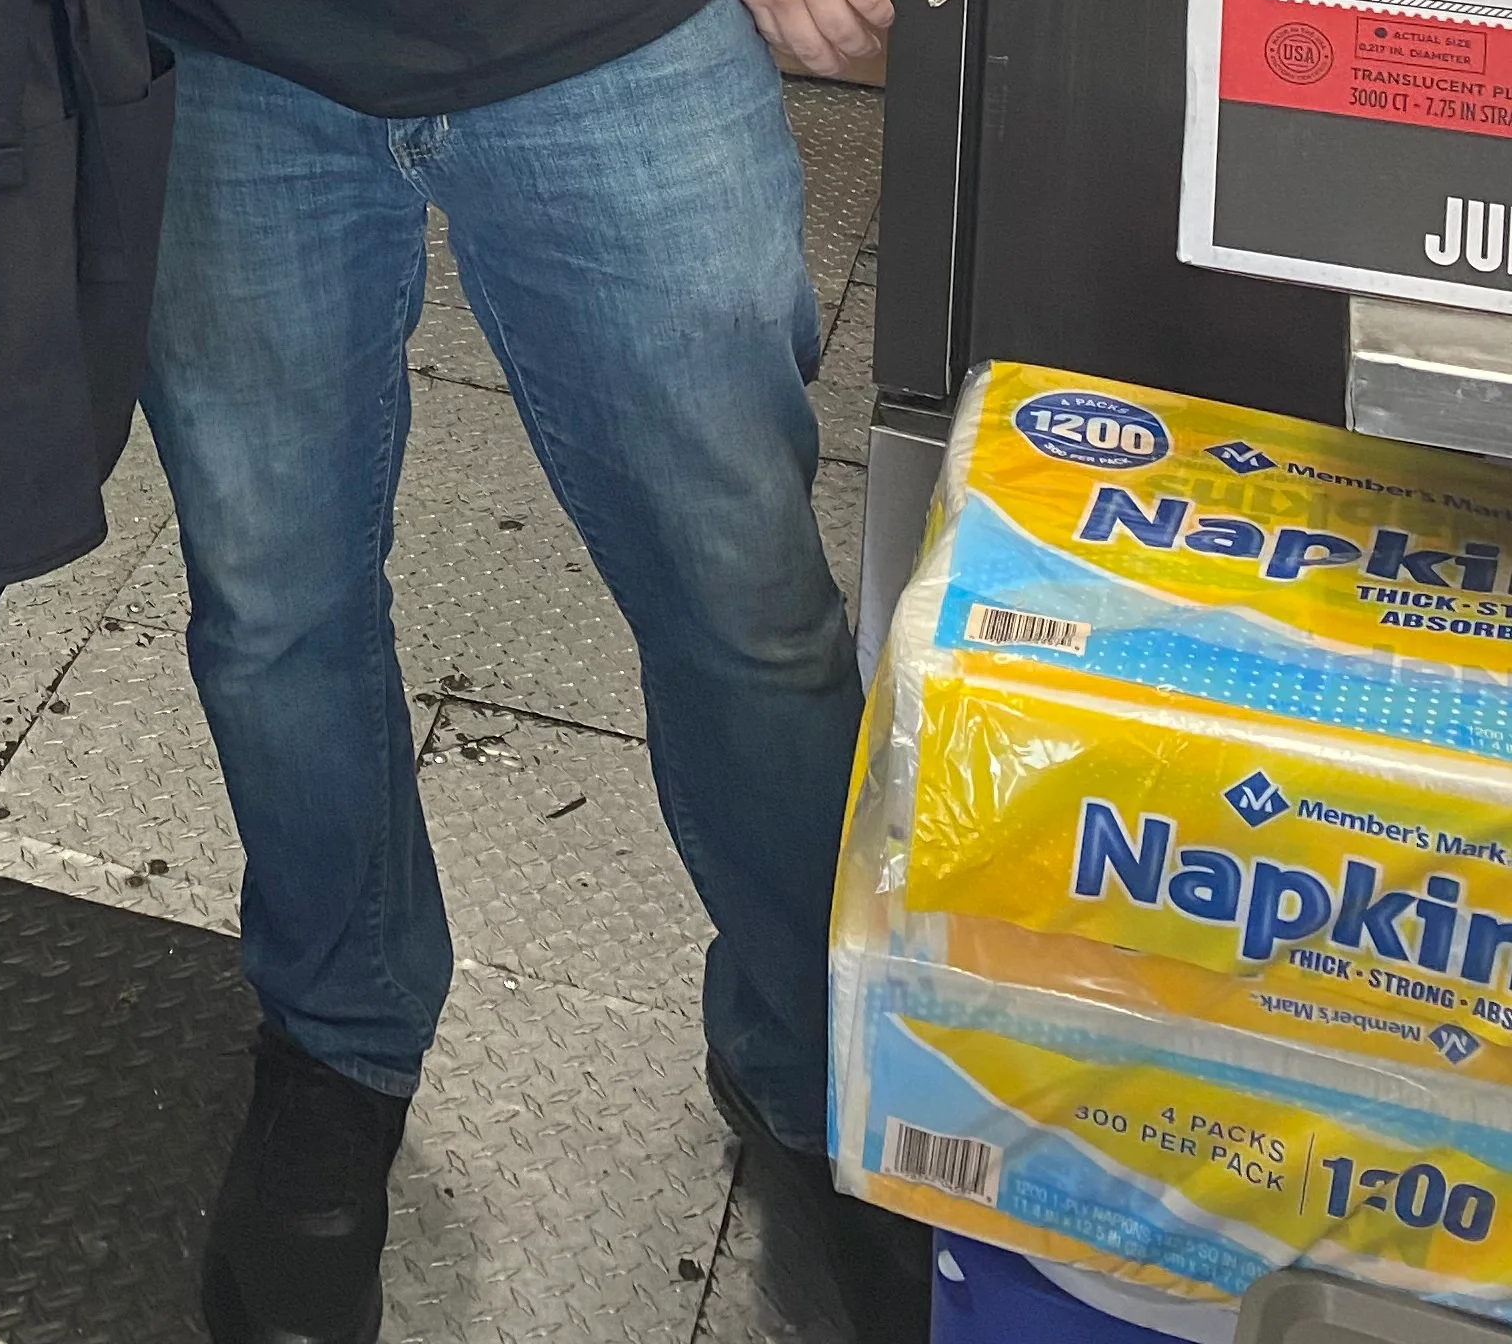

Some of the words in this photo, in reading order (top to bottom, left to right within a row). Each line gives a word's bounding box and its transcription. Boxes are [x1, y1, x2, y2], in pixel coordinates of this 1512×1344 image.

[1283, 43, 1315, 65] USA
[1358, 42, 1386, 54] 0.217
[1409, 48, 1472, 65] DIAMETER
[1393, 31, 1442, 46] ACTUAL
[1445, 35, 1473, 49] SIZE
[1350, 67, 1487, 98] TRANSLUCENT
[1348, 86, 1388, 110] 3000
[1392, 93, 1410, 113] CT
[1425, 96, 1456, 119] 7.75
[1460, 101, 1477, 122] IN
[1424, 195, 1512, 275] JU
[1075, 398, 1130, 414] PACKS
[1030, 410, 1156, 456] 1200
[1287, 462, 1437, 505] Member's
[1076, 486, 1512, 596] Napki
[1357, 584, 1458, 613] THICK
[1379, 611, 1512, 640] ABSORB
[1296, 799, 1431, 850] Member's
[1435, 831, 1507, 864] Mark
[1288, 949, 1352, 981] THICK
[1367, 968, 1456, 1010] STRONG
[1259, 993, 1315, 1021] Mark
[1317, 1004, 1422, 1043] Member's
[1074, 1105, 1128, 1134] 300
[1141, 1123, 1198, 1157] PER
[1210, 1144, 1285, 1193] PACK
[1160, 1106, 1176, 1125] 4
[1190, 1114, 1286, 1164] PACKS
[1091, 1205, 1152, 1244] NAPKINS
